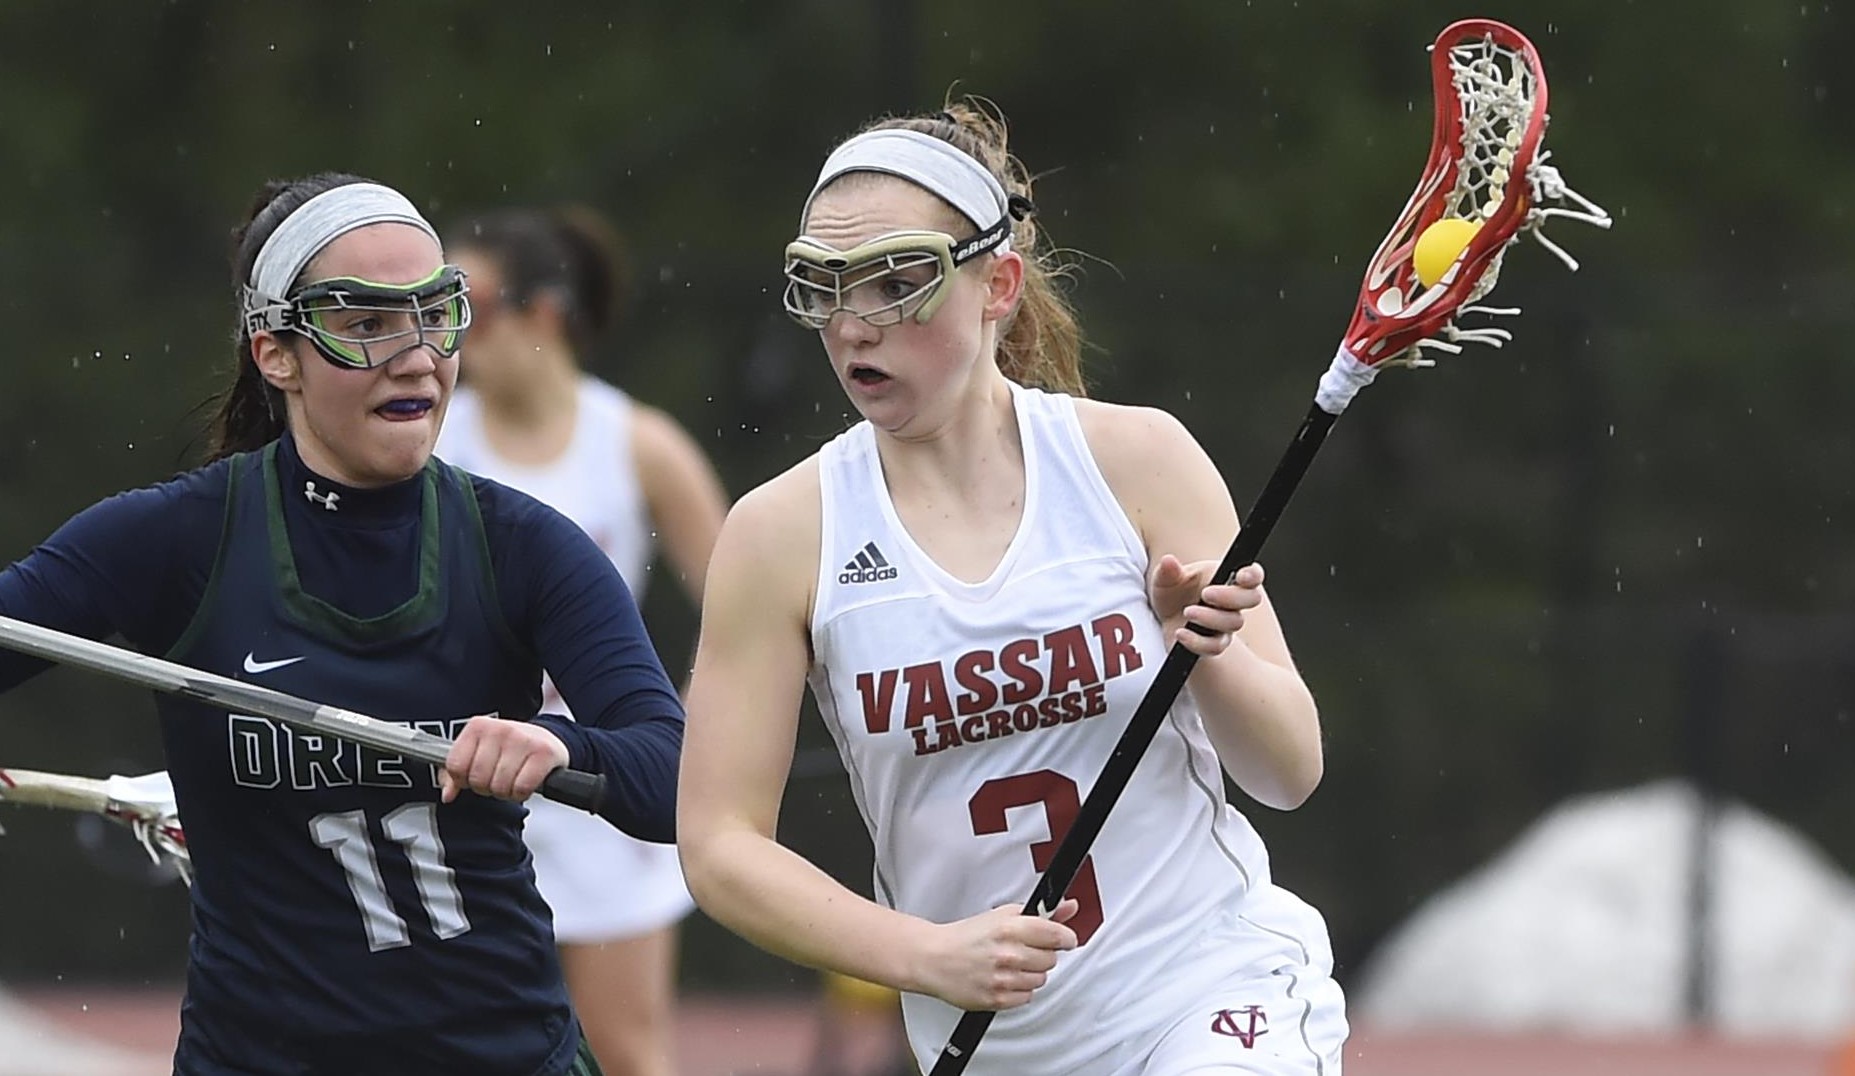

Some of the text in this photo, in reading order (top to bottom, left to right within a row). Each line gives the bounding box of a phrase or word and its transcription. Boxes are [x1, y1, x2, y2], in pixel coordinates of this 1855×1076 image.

[951, 227, 1004, 261] eBeer
[838, 566, 899, 585] adidas
[856, 613, 1144, 735] VASSAR
[228, 711, 500, 791] DRE
[911, 685, 1108, 757] LACROSSE
[308, 801, 472, 953] 11
[968, 768, 1105, 948] 3
